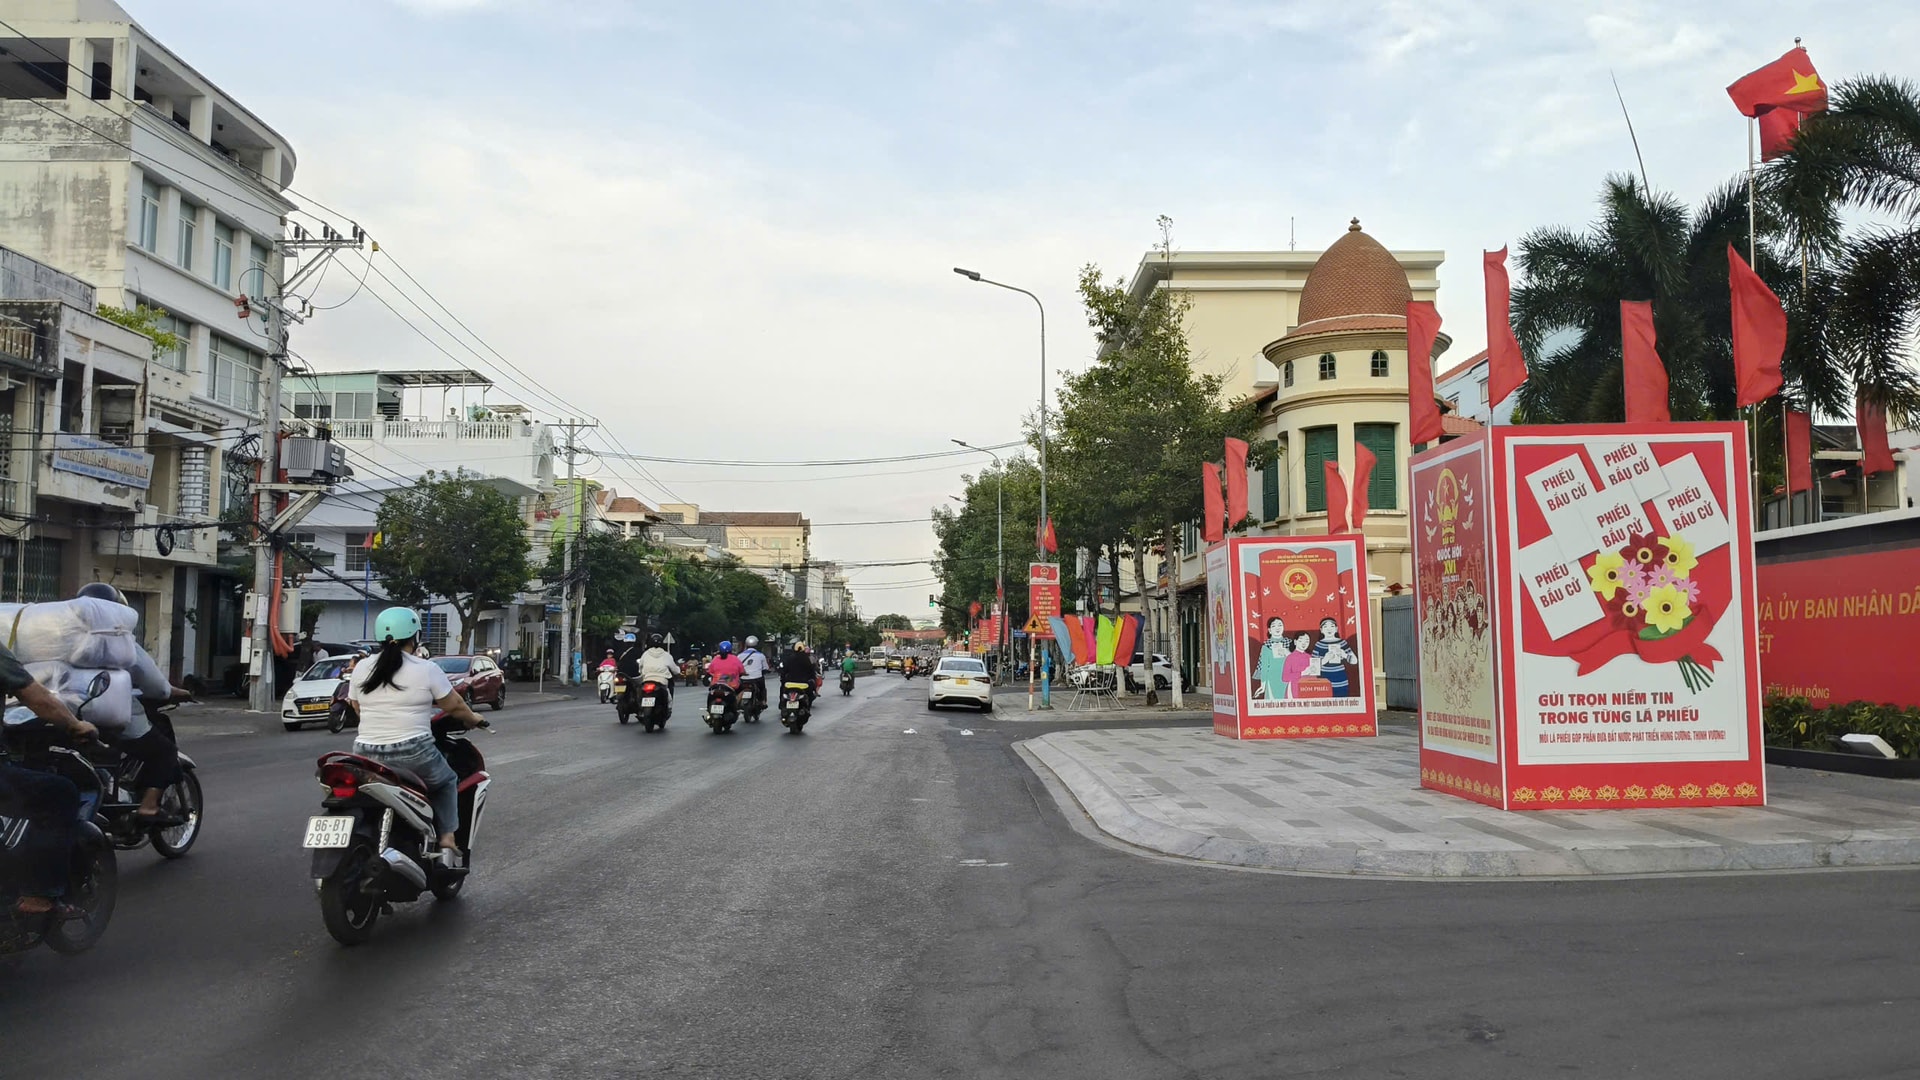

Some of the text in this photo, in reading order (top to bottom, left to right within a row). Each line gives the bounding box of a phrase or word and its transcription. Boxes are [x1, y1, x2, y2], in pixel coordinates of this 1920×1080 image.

[1603, 442, 1638, 467] PHIẾU
[1541, 466, 1576, 492] PHIẾU
[1608, 457, 1650, 486] BẦU CỬ
[1546, 483, 1588, 512] BẦU CỬ
[1667, 486, 1702, 512] PHIẾU
[1597, 503, 1631, 528] PHIẾU
[1672, 500, 1714, 532] BẦU CỬ
[1602, 517, 1644, 548] BẦU CỬ
[1535, 562, 1570, 588] PHIẾU
[1540, 577, 1582, 608] BẦU CỬ
[1779, 592, 1799, 620] ỦY
[1805, 598, 1838, 619] BAN
[1843, 588, 1892, 617] NHÂN
[1539, 689, 1674, 707] GỬI TRỌN NIỀM TIN
[1539, 705, 1699, 724] TRONG TỪNG LÁ PHIẾU
[307, 833, 348, 846] 299.30
